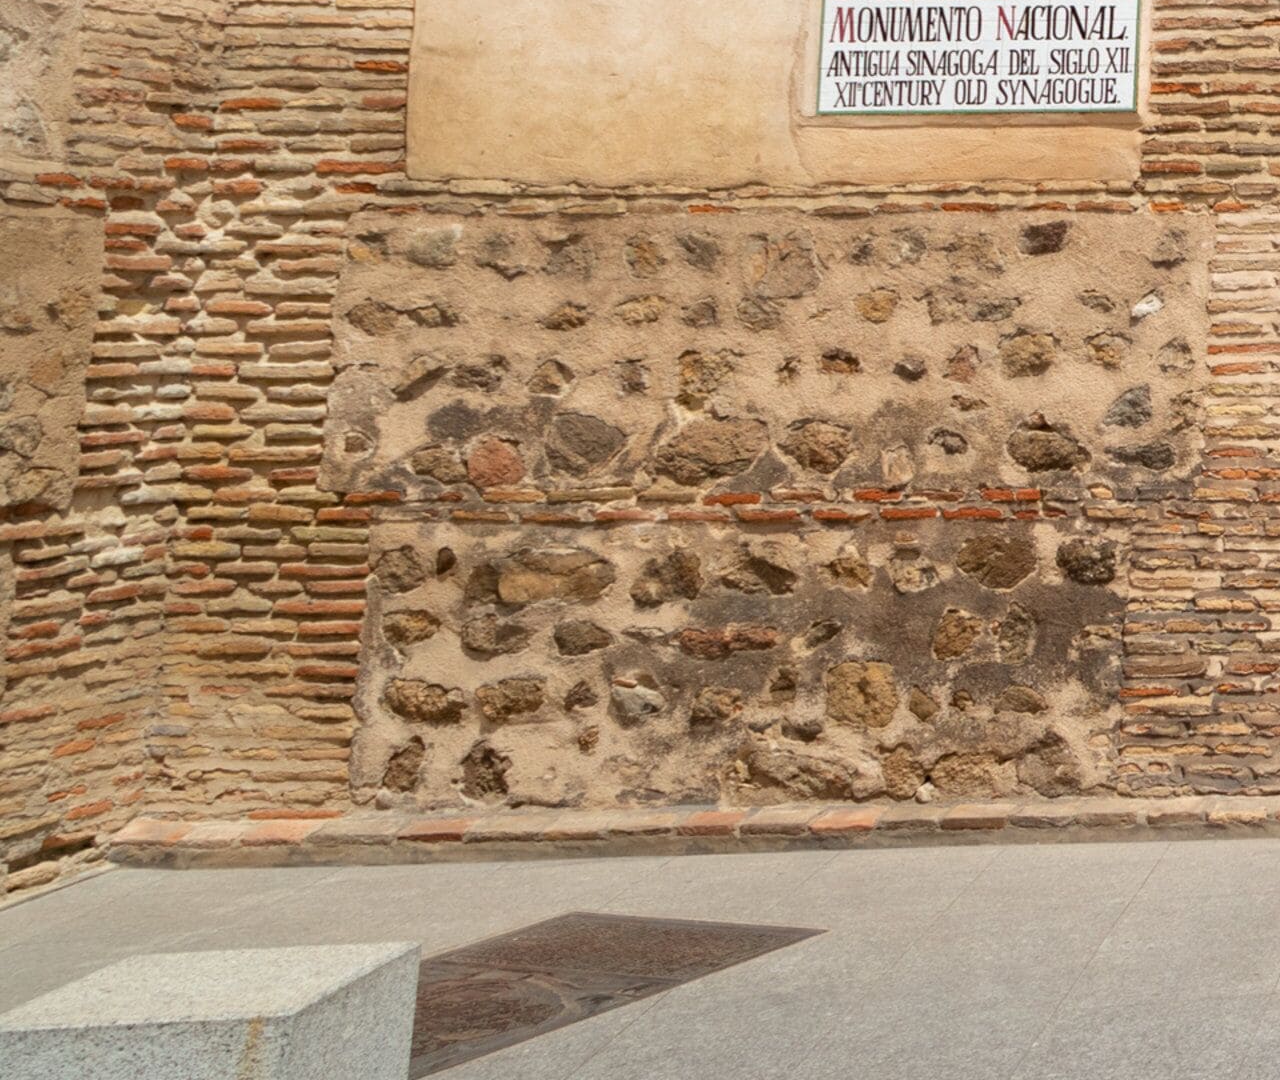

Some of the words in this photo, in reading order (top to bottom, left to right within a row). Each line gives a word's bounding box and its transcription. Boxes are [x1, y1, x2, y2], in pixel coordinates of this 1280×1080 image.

[829, 6, 982, 43] MONUMENTO
[996, 5, 1129, 41] NACIONAL.
[826, 50, 900, 77] ANTIGUA
[906, 49, 999, 77] SINAGOGA
[1008, 49, 1040, 76] DEL
[1048, 48, 1100, 74] SIGLO
[862, 80, 947, 107] CENTURY
[954, 78, 988, 105] OLD
